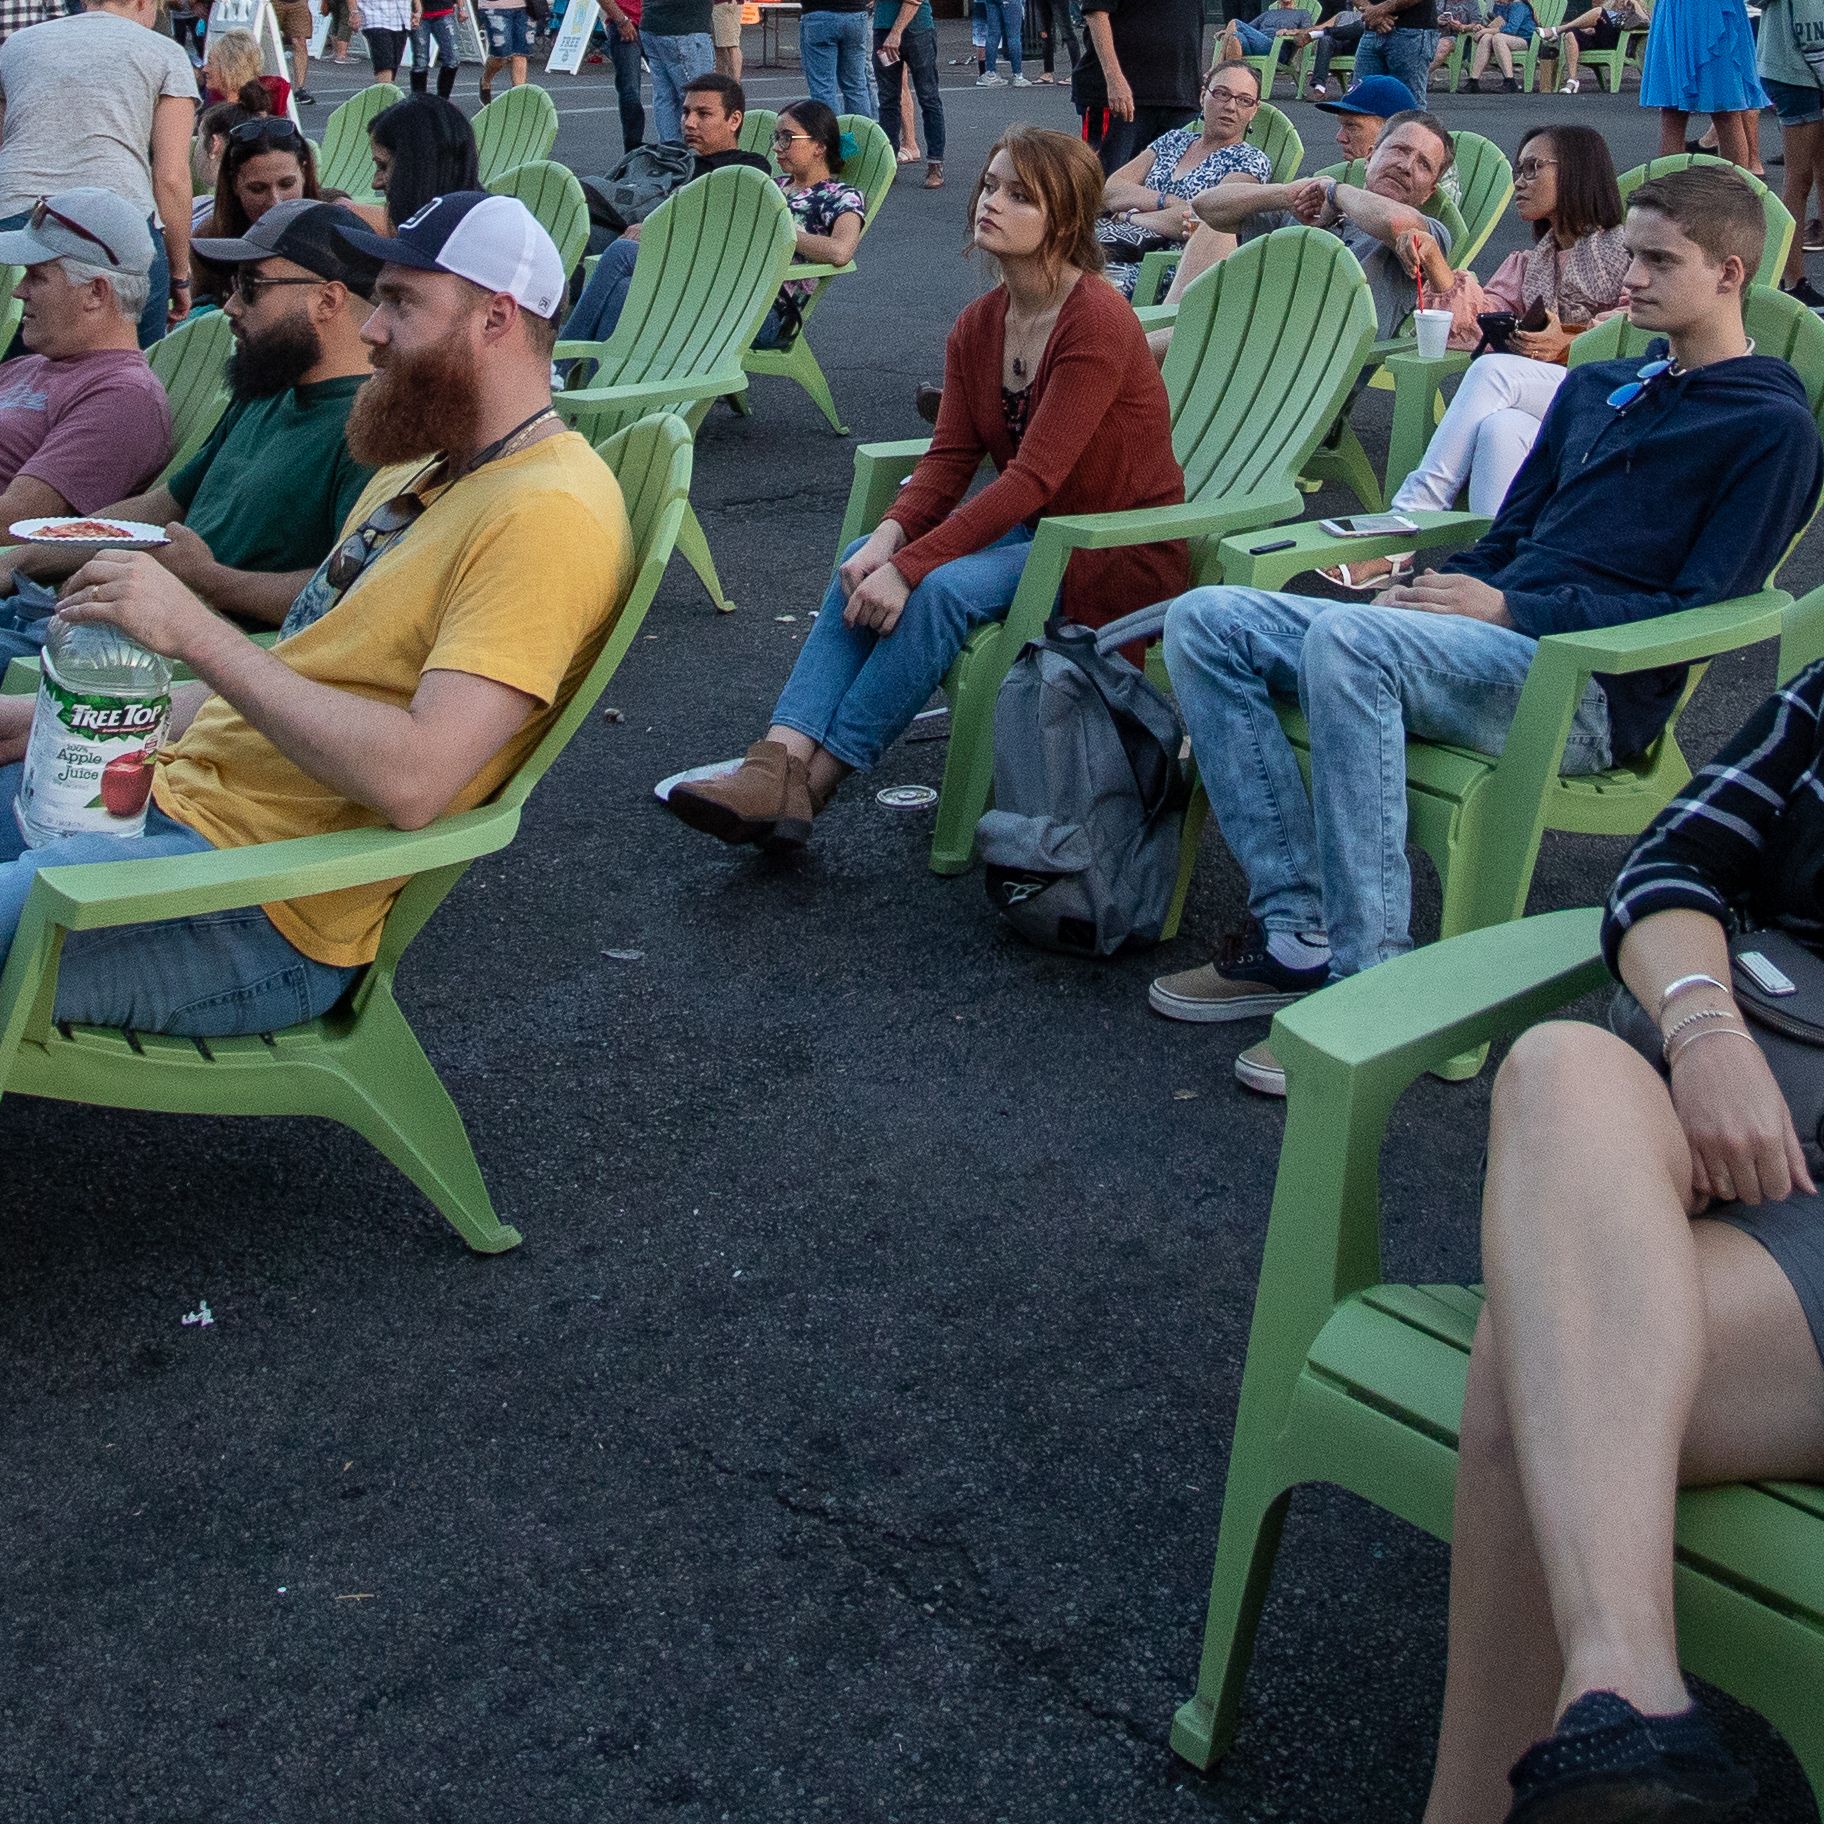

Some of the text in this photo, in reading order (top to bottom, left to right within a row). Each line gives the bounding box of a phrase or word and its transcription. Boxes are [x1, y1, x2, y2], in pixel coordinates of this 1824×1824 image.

[70, 703, 164, 729] TREE TOP
[56, 748, 103, 766] Apple
[57, 765, 99, 782] Juice
